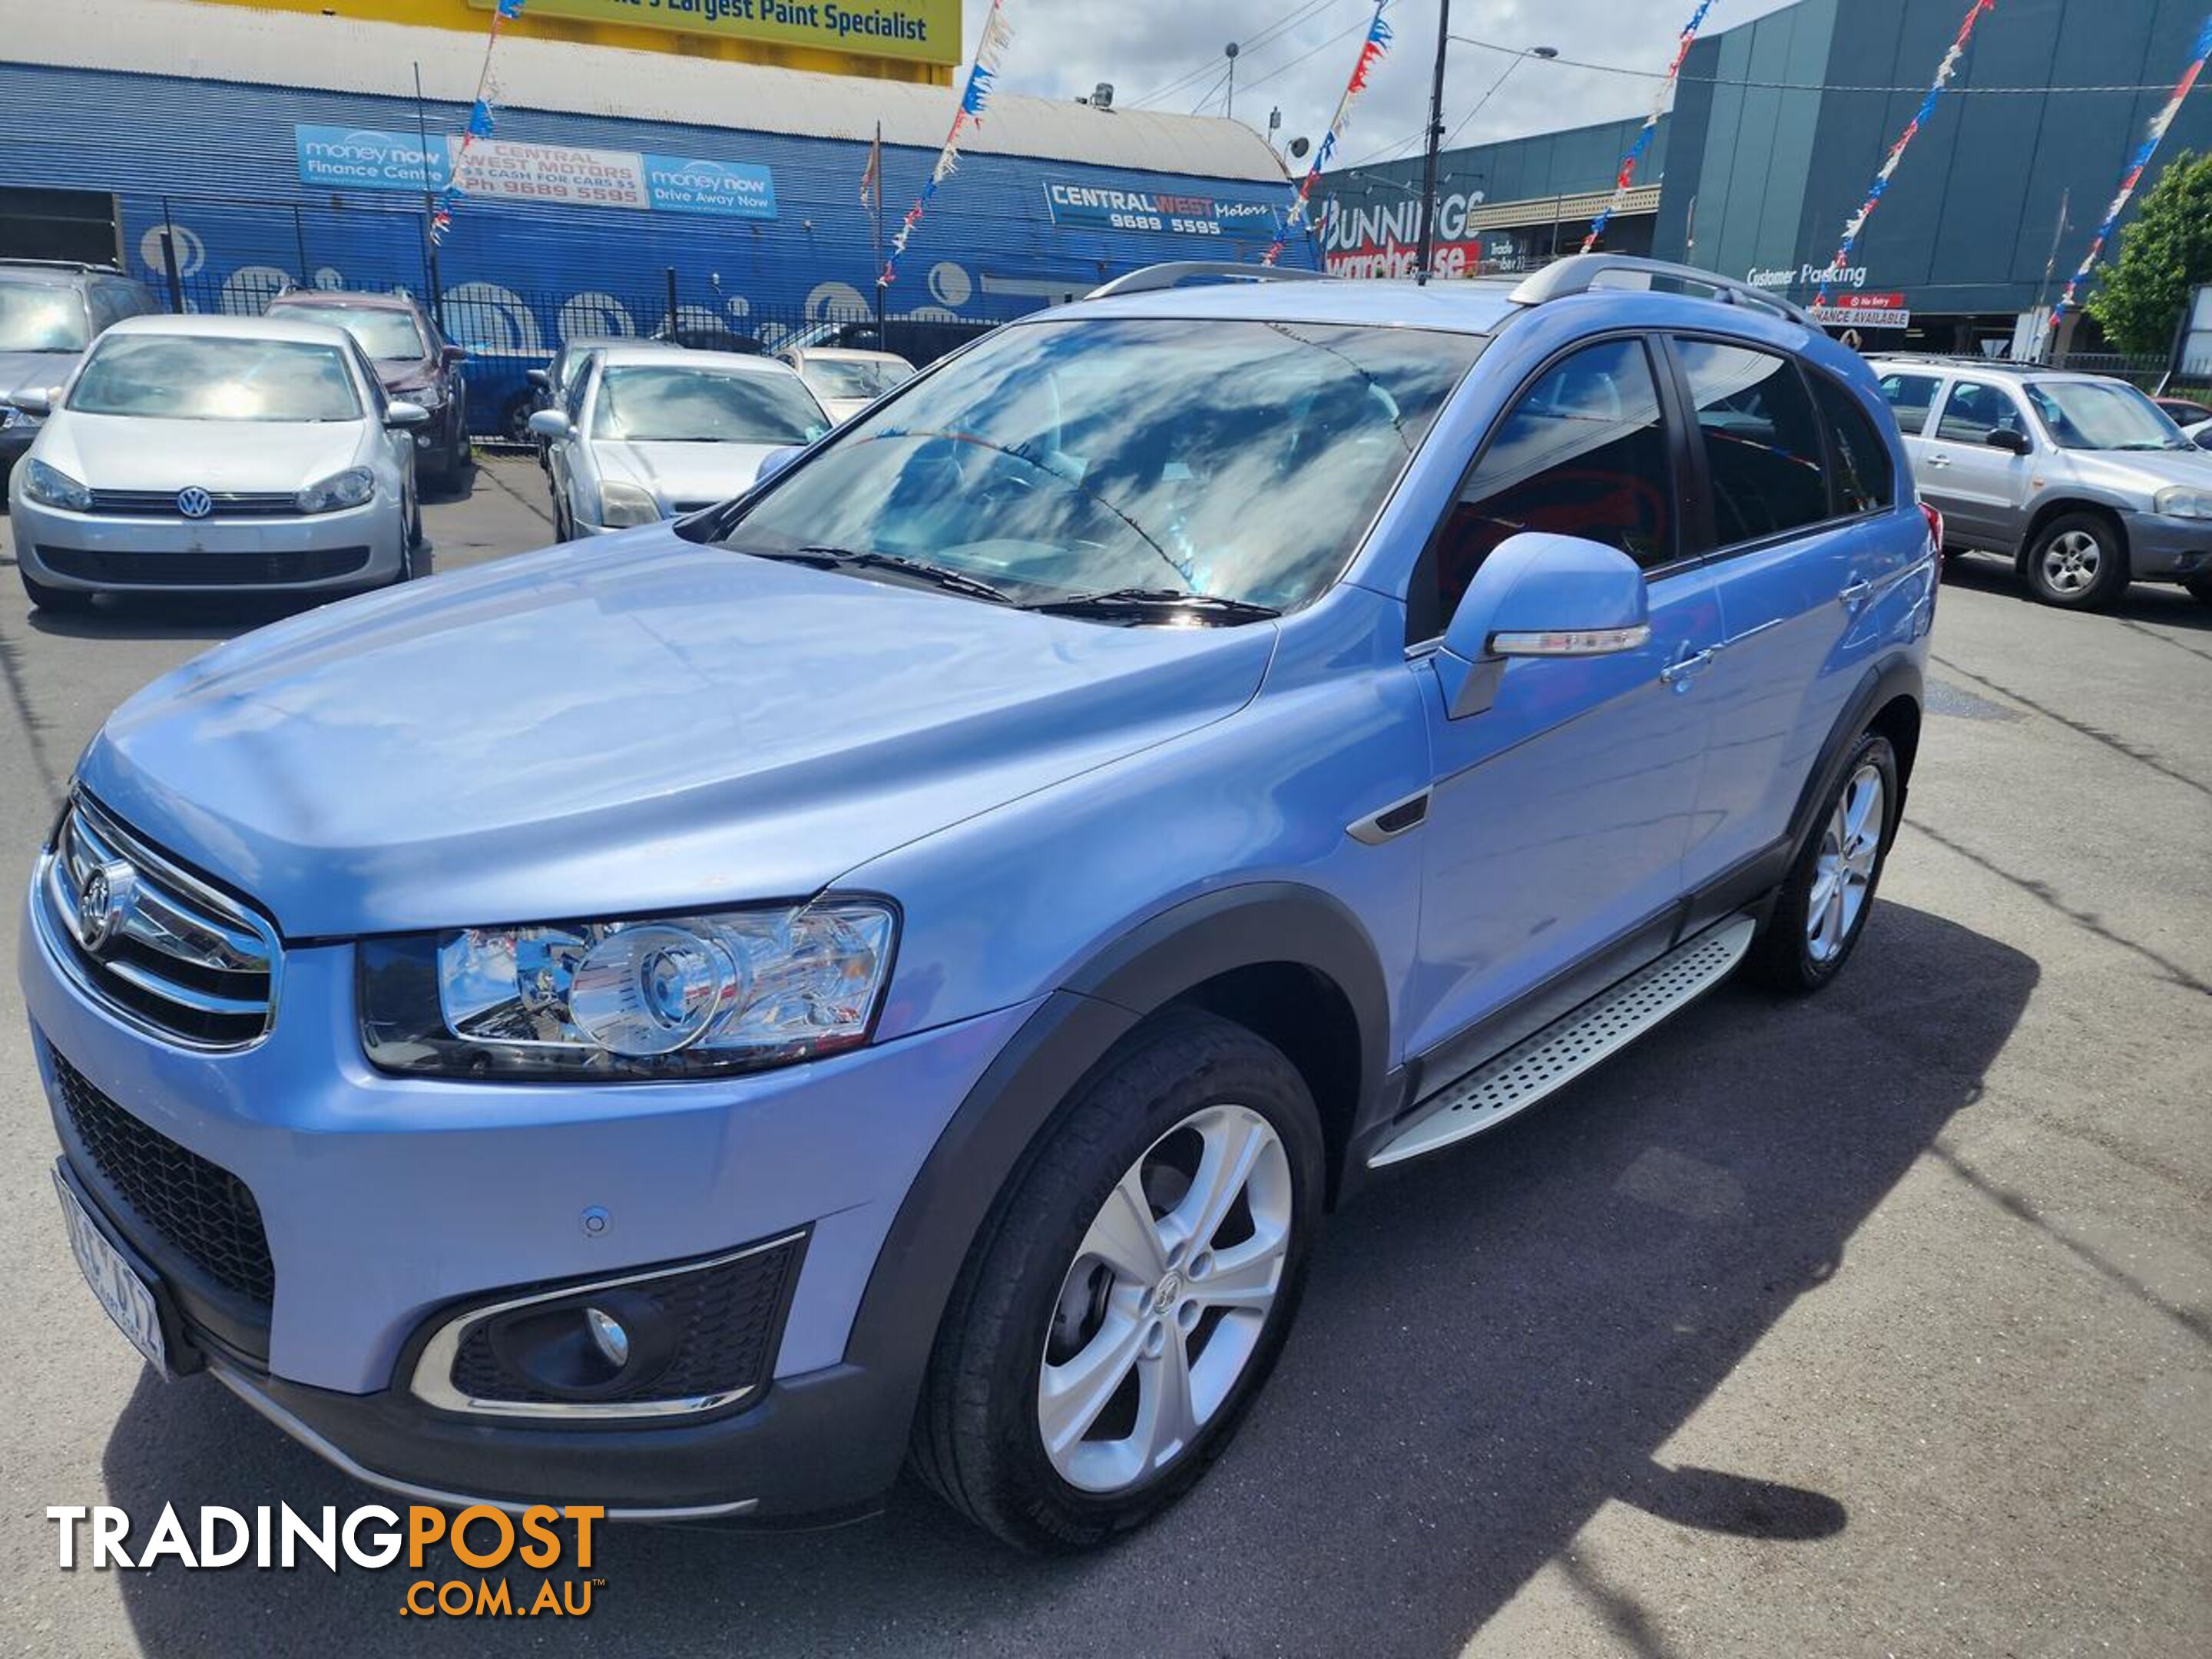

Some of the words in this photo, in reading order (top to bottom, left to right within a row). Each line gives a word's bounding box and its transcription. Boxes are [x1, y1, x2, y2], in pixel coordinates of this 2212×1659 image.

[760, 0, 818, 28] Paint
[825, 3, 927, 41] Specialist
[306, 141, 387, 165] money
[390, 151, 441, 165] now
[495, 144, 600, 164] CENTRAL
[307, 160, 378, 177] Finance
[464, 155, 529, 170] WEST
[538, 161, 634, 179] MOTORS
[488, 169, 531, 180] CASH
[538, 173, 568, 184] FOR
[572, 176, 613, 187] CARS
[464, 177, 495, 192] Ph
[503, 180, 568, 197] 9689
[578, 187, 638, 203] 5595
[651, 171, 720, 192] money
[724, 178, 765, 193] now
[654, 187, 692, 202] Drive
[695, 191, 734, 207] Away
[737, 195, 768, 207] Now
[1214, 202, 1269, 219] Motors
[1320, 190, 1485, 250] BUNNIGS
[1110, 213, 1162, 230] 9689
[1171, 218, 1222, 235] 5595
[1327, 234, 1465, 279] warehose
[1747, 267, 1796, 286] Customer
[1800, 263, 1867, 288] Paking
[1853, 310, 1906, 326] AVAILABLE
